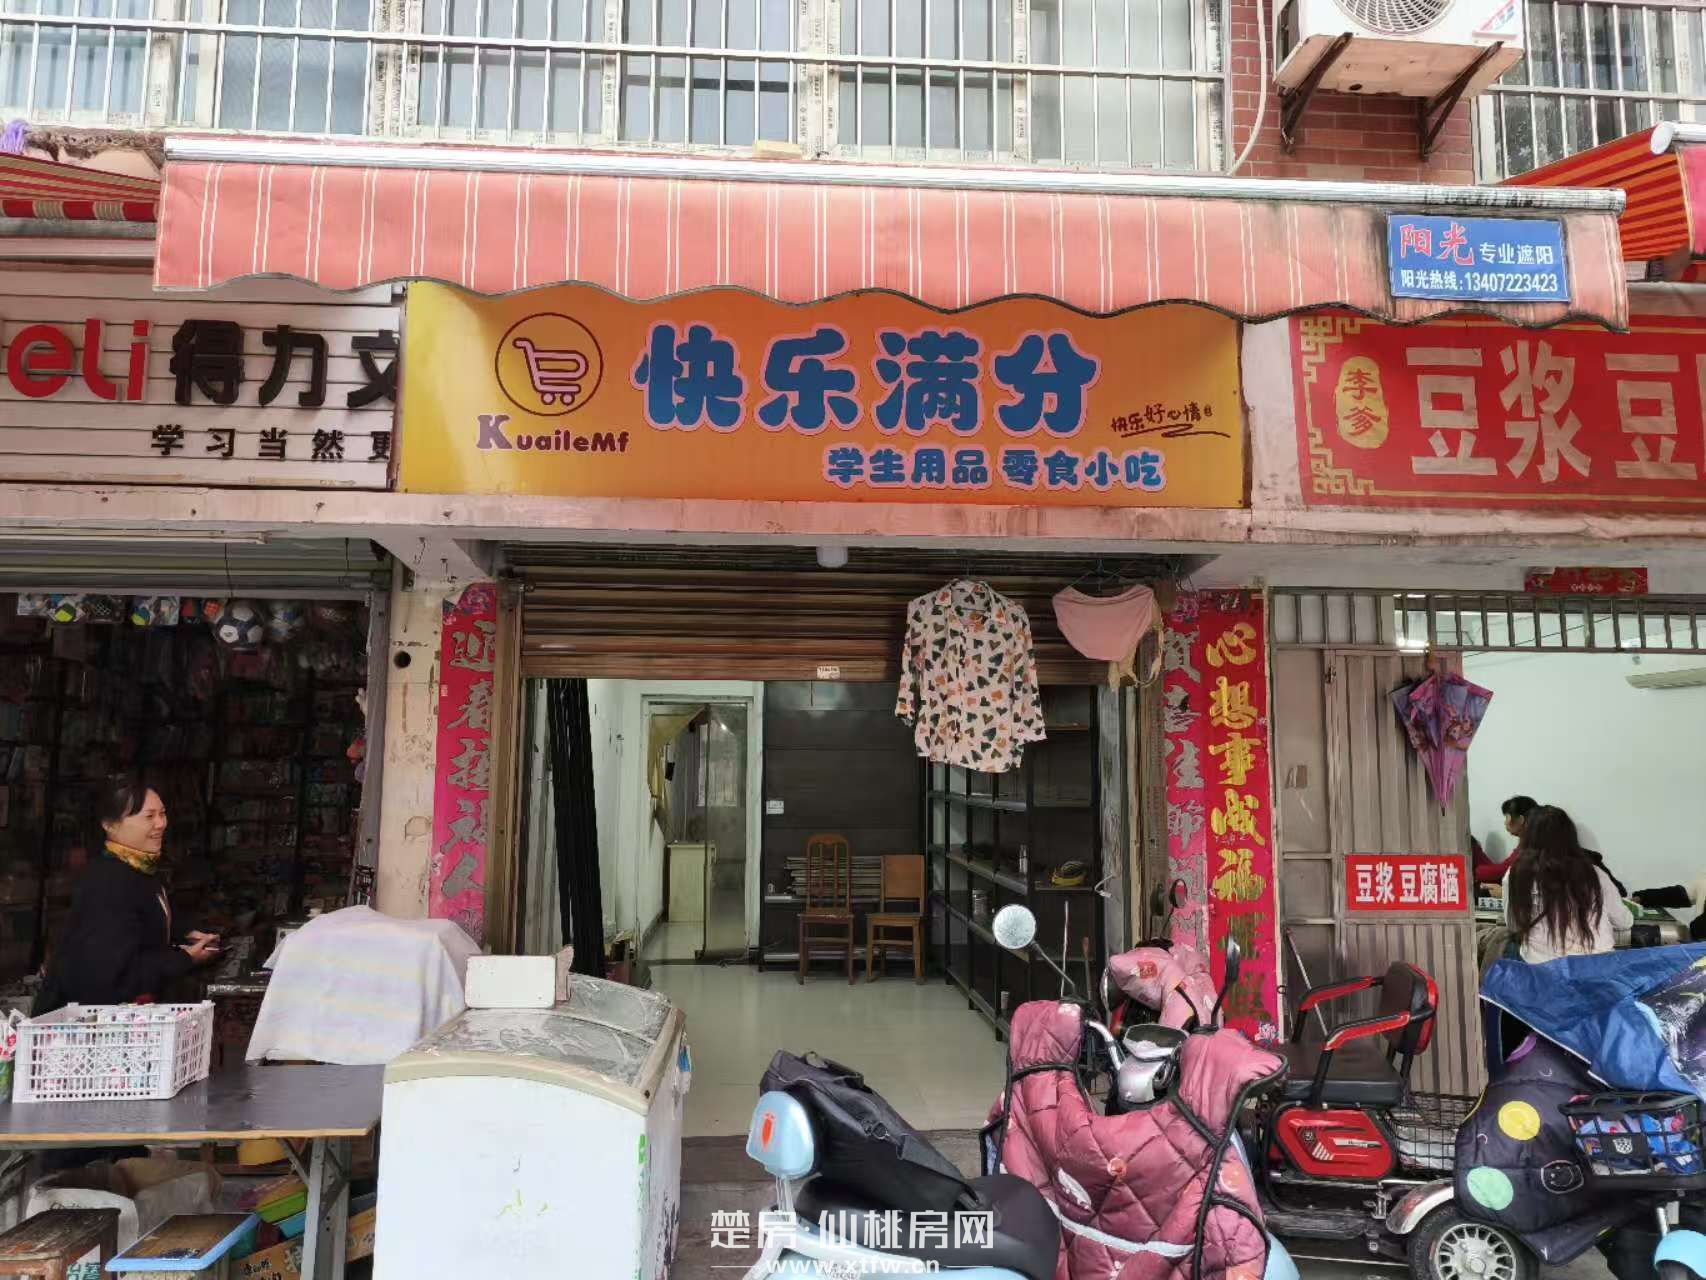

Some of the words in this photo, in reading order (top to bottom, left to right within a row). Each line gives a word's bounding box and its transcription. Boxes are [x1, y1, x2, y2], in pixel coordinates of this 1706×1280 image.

[1400, 223, 1475, 266] 阳光
[1480, 243, 1554, 265] 专业遮阳
[632, 320, 1100, 438] 快乐满分
[476, 413, 630, 453] KuaileMf
[1111, 401, 1202, 433] 快乐好心情
[1405, 339, 1706, 484] 豆浆豆
[826, 447, 989, 487] 学生用品
[1001, 448, 1164, 488] 零食小吃
[1355, 861, 1396, 905] 豆浆
